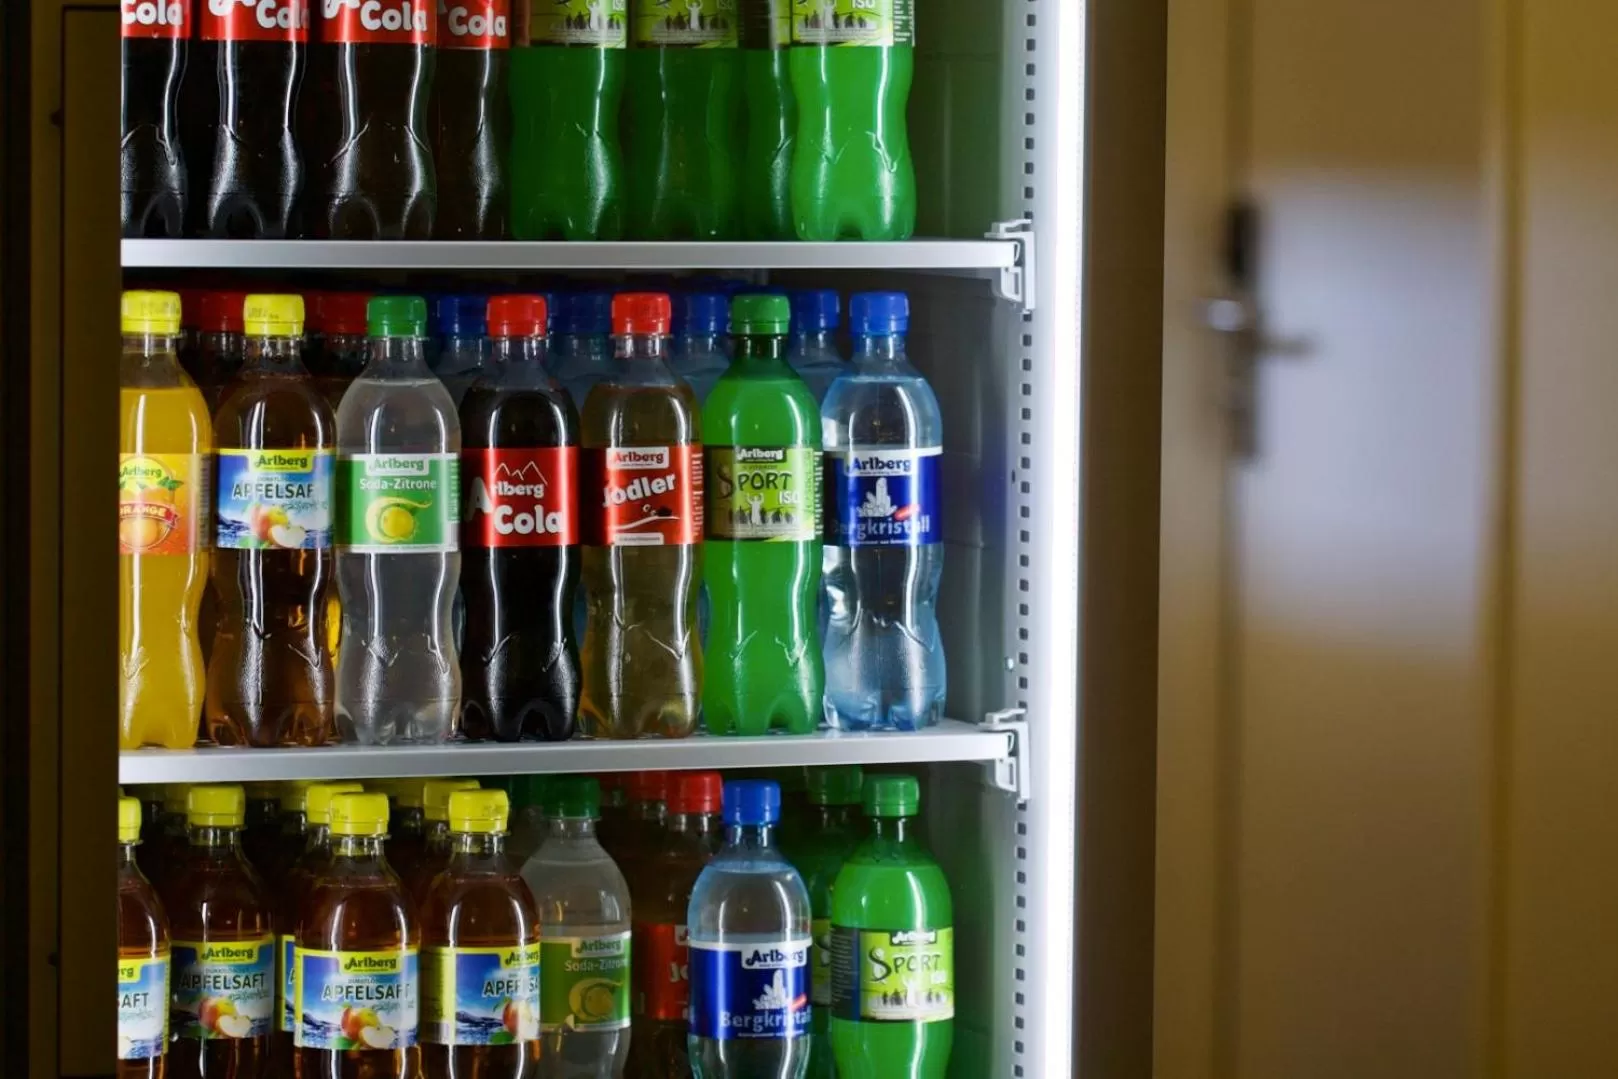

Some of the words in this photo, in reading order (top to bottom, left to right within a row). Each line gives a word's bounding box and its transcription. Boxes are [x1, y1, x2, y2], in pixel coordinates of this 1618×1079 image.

[360, 0, 427, 31] Cola
[448, 6, 507, 37] Cola
[255, 454, 309, 470] Arlberg
[611, 451, 665, 465] Arlberg
[736, 448, 784, 461] Arlberg
[368, 457, 425, 472] Arlberg
[850, 456, 912, 473] Arlberg
[359, 478, 437, 491] Soda-Zitrone
[602, 472, 676, 508] Jodler
[716, 463, 793, 500] SPORT
[232, 483, 318, 500] APFELSAF
[493, 503, 567, 536] Cola
[201, 947, 255, 960] Arlberg
[745, 949, 804, 967] Arlberg
[344, 956, 398, 971] Arlberg
[564, 958, 629, 973] Soda-Zitro
[868, 946, 943, 983] SPORT
[179, 972, 266, 990] APFELSAFT
